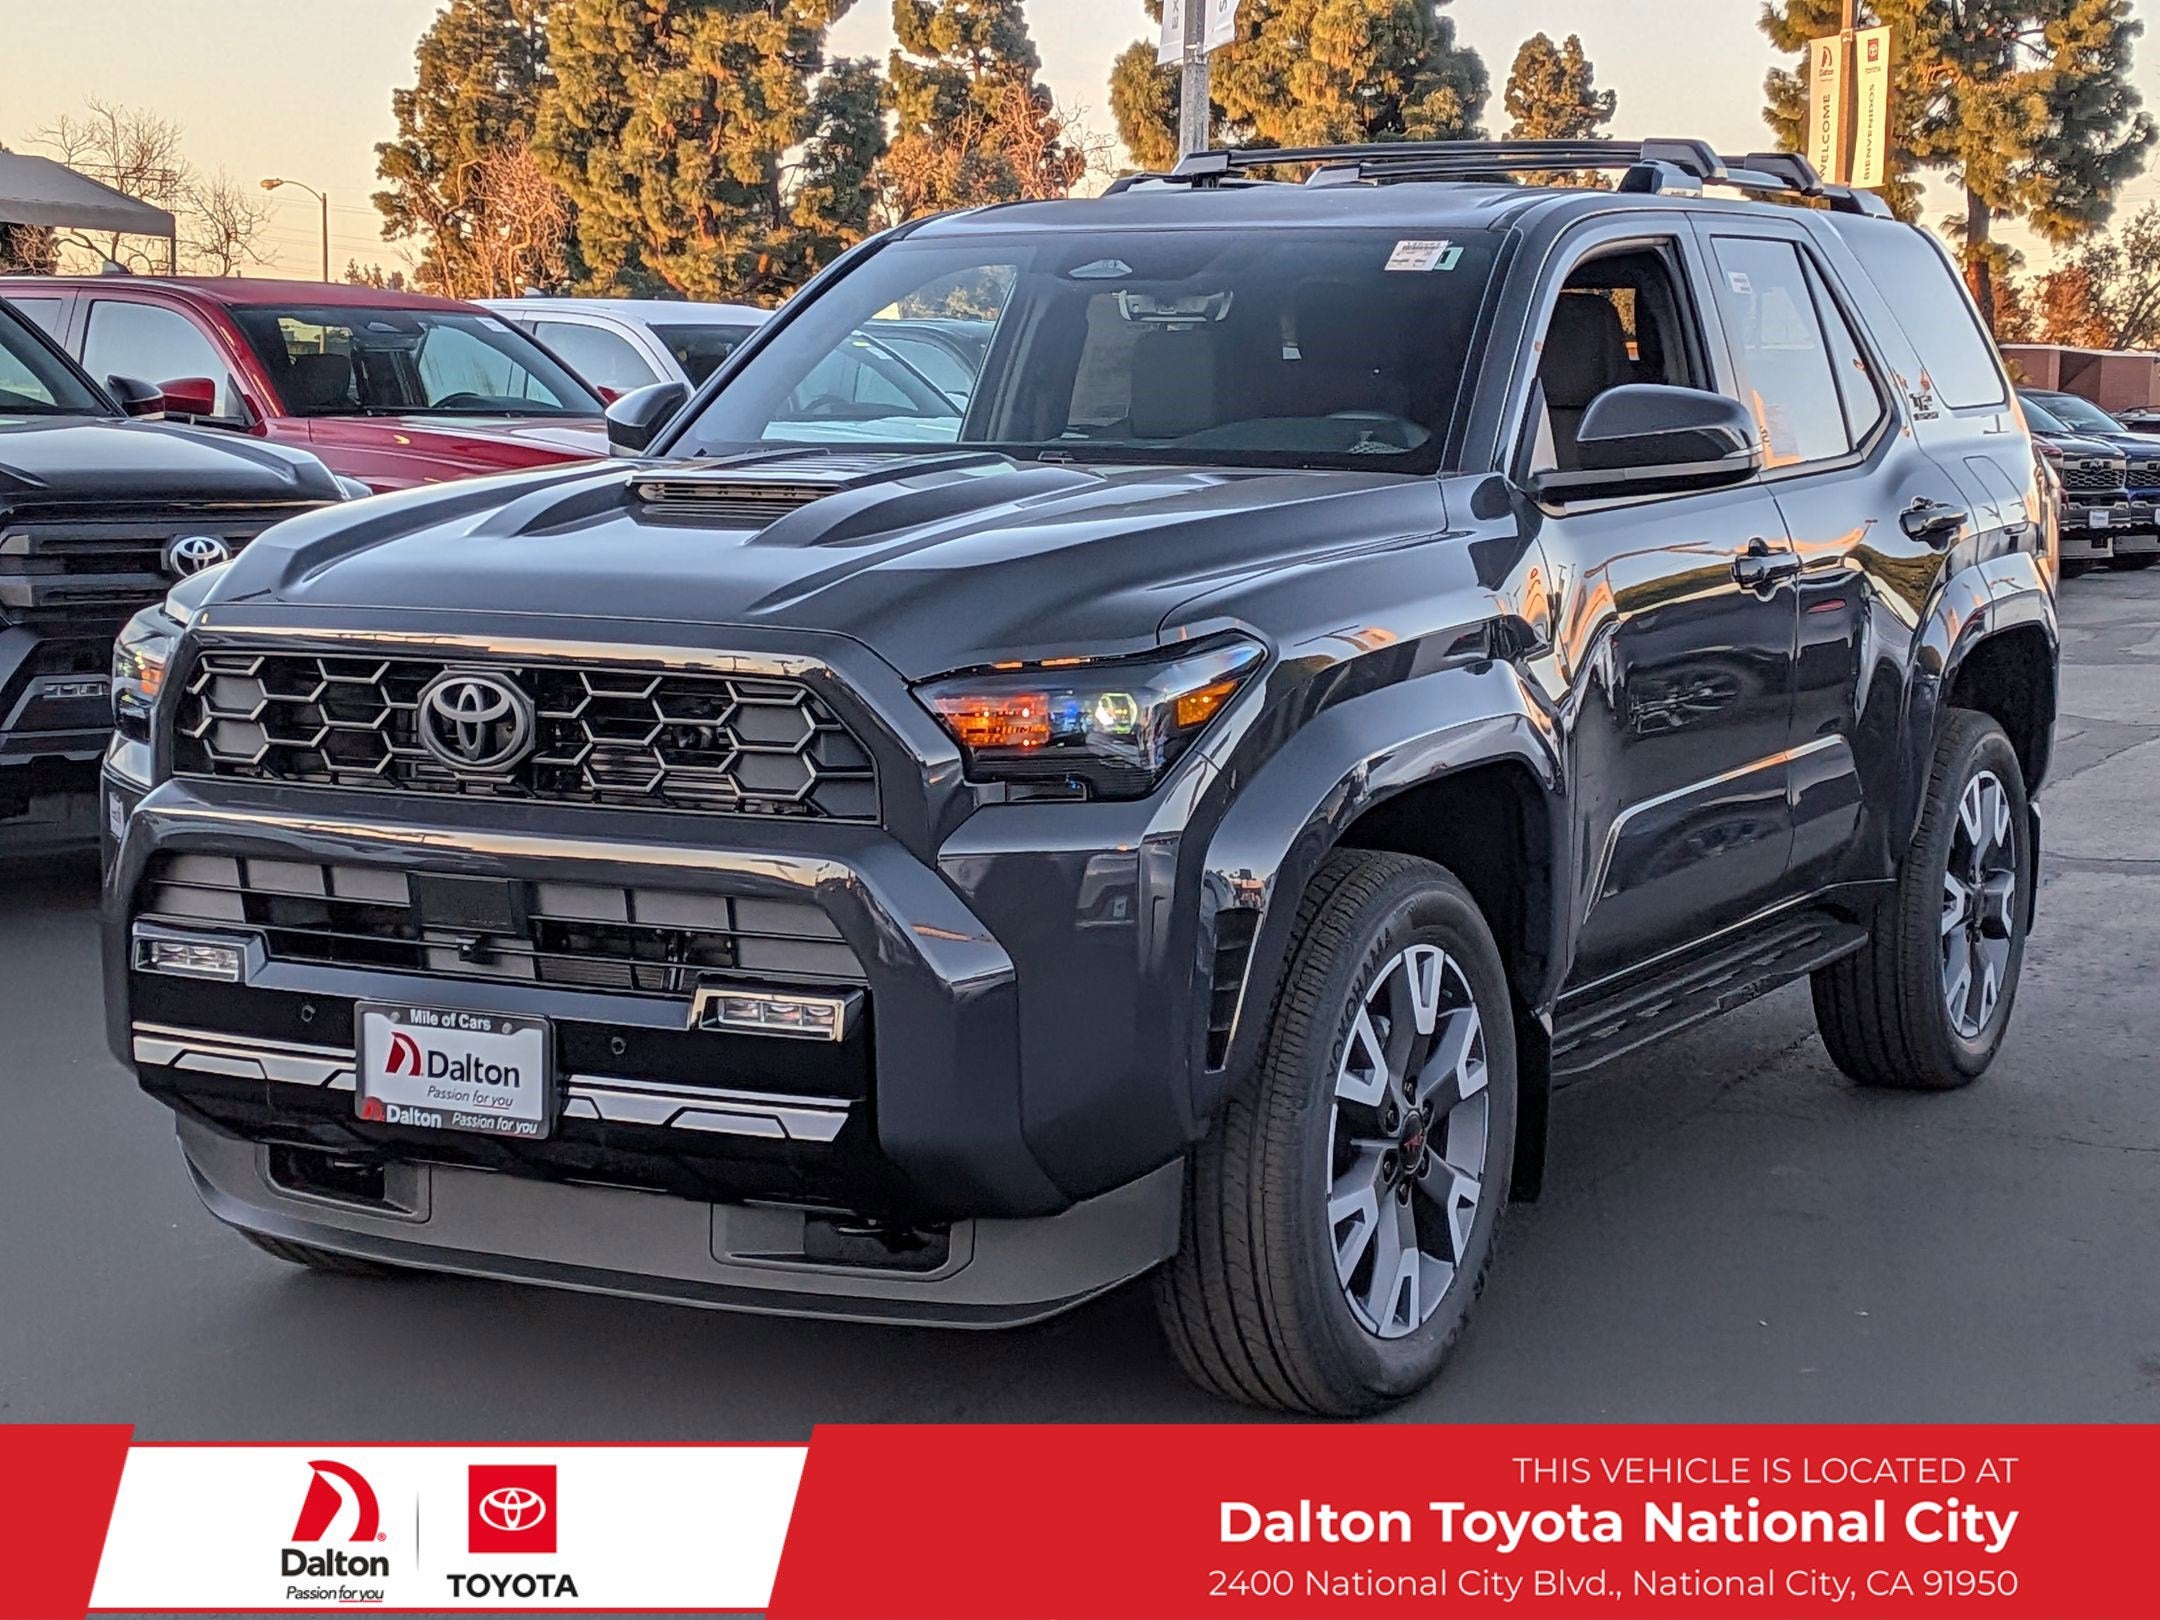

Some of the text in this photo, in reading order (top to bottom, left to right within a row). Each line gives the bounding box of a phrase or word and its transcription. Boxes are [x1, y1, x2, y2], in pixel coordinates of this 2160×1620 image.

[1819, 94, 1831, 179] WELCOME
[1863, 83, 1875, 180] BIENVENIDOS
[410, 1008, 492, 1031] Mile of Cars
[427, 1050, 520, 1088] Dalton
[427, 1085, 514, 1108] Passion for you
[386, 1105, 539, 1136] Dalton Passion for you
